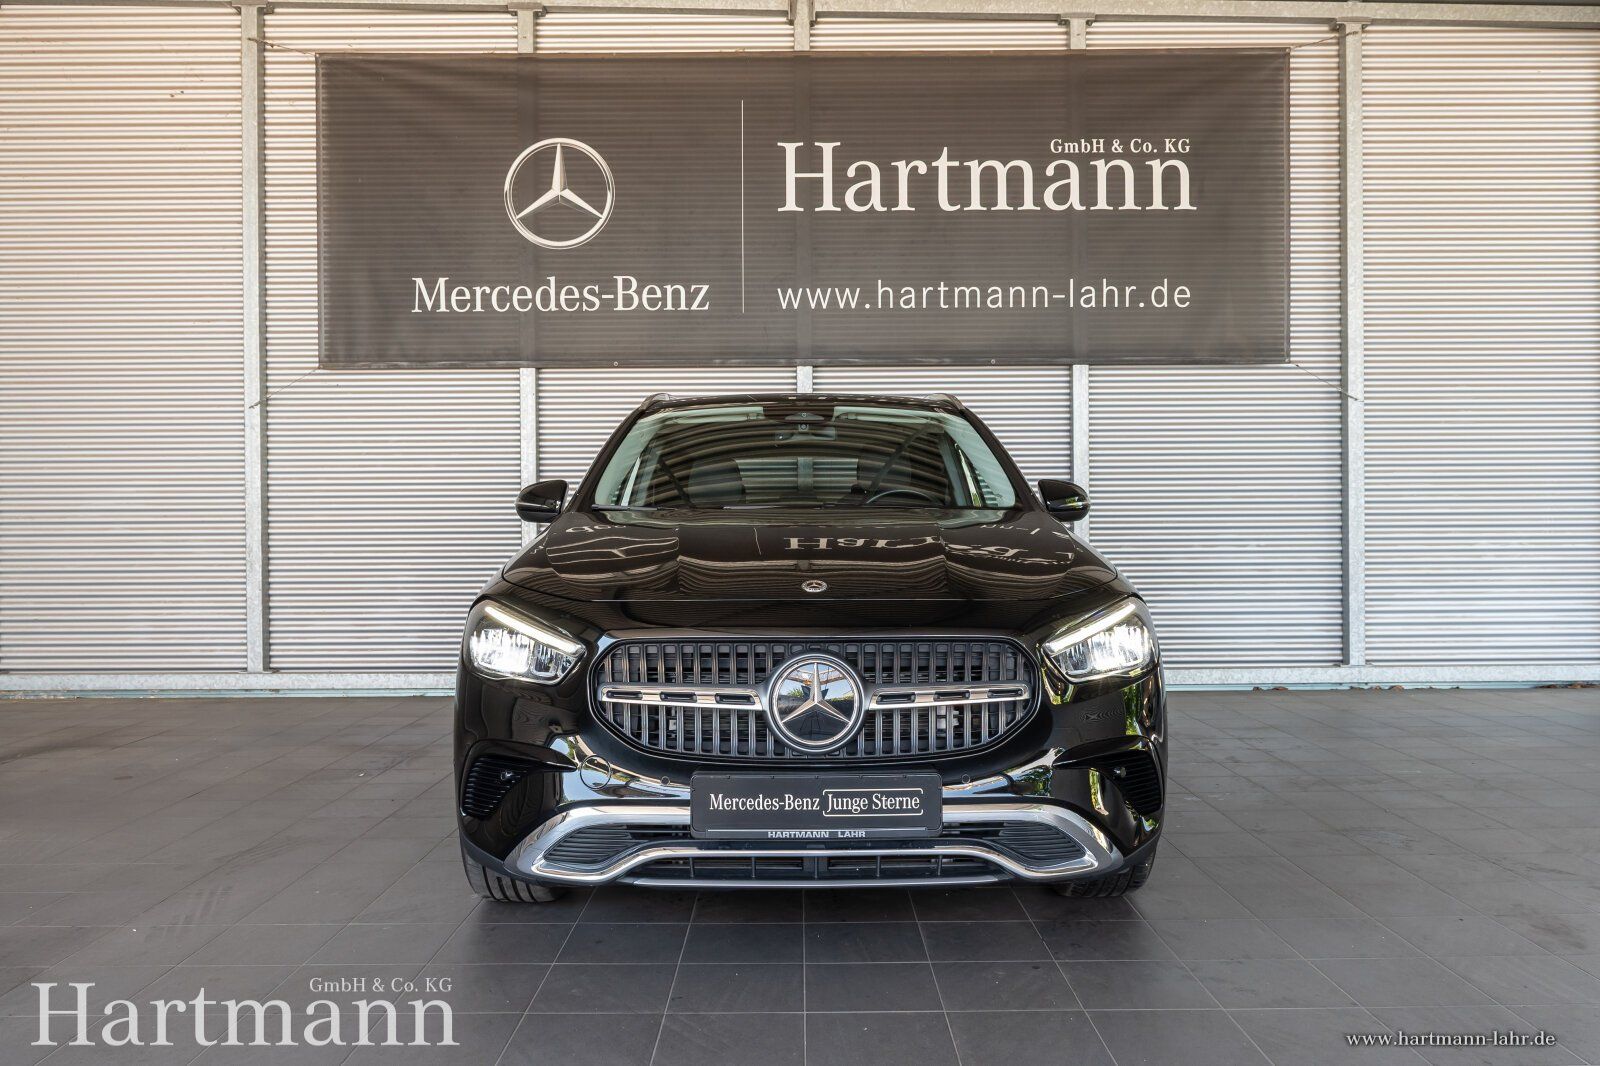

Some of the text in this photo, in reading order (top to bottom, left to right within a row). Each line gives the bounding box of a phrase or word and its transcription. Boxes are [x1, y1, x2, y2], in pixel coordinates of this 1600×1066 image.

[1050, 138, 1191, 153] GmbH & Co. KG
[777, 141, 1198, 212] Hartmann
[411, 275, 710, 312] Mercedes-Benz
[777, 278, 1191, 309] www.hartmann-lahr.de
[709, 792, 920, 814] Mercedes-Benz Junge Sterne
[768, 830, 866, 839] HARTMANN LAHR
